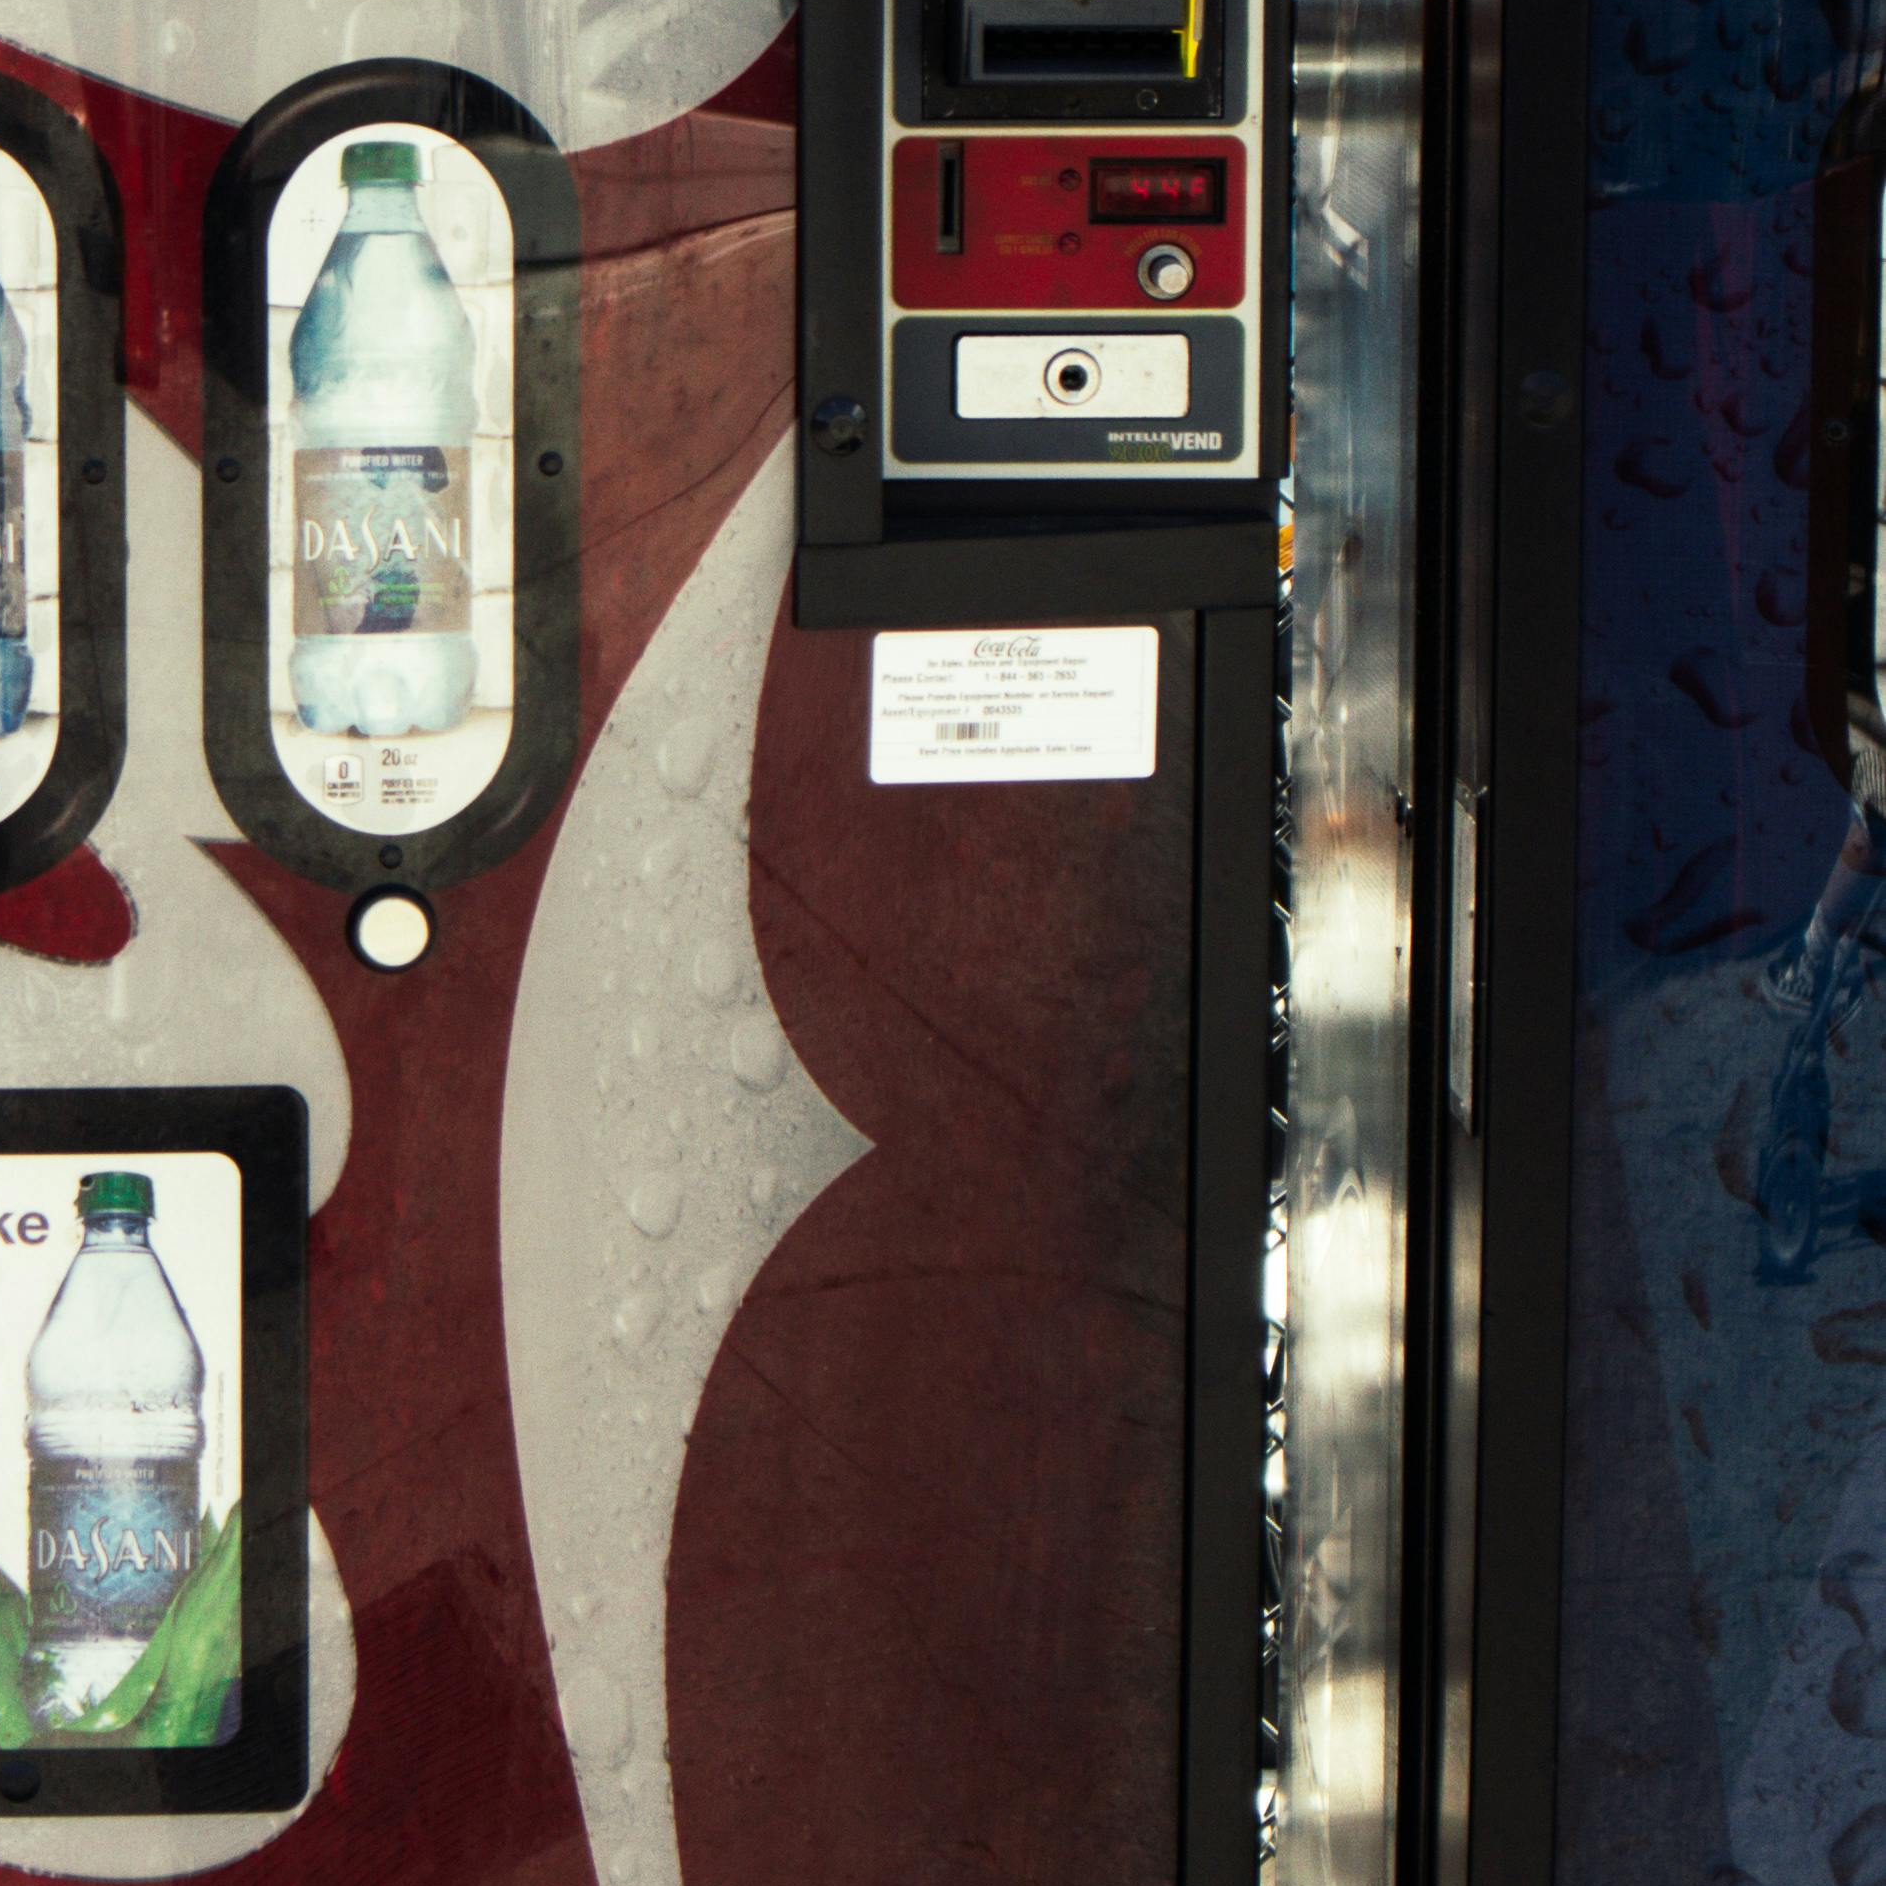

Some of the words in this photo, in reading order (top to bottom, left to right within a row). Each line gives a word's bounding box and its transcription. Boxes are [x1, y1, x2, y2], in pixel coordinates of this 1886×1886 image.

[303, 504, 461, 574] DASANI
[338, 761, 348, 779] 0
[381, 748, 401, 766] 20
[38, 1515, 192, 1584] DASANI
